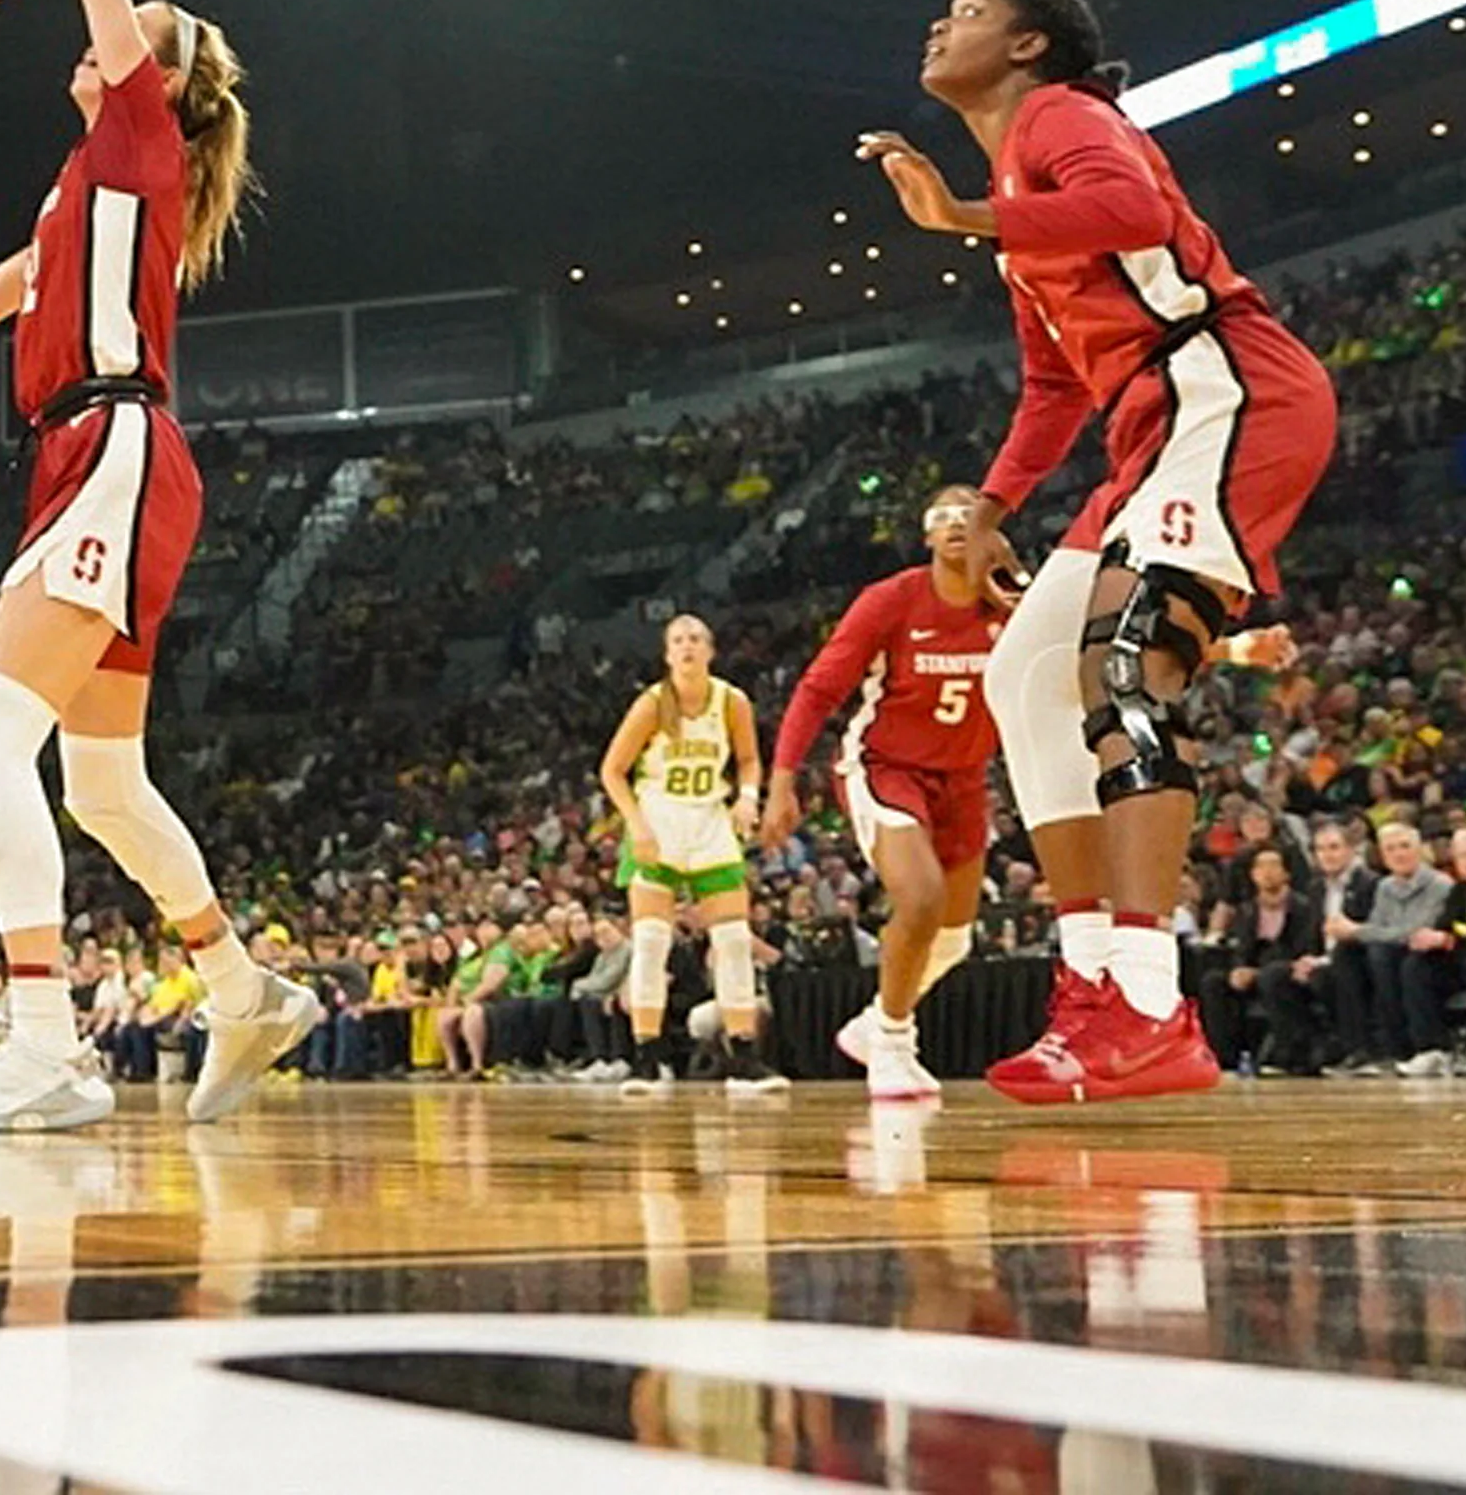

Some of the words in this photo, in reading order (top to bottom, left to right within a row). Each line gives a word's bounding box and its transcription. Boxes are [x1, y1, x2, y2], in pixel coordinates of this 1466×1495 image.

[1160, 499, 1196, 548] S
[73, 535, 107, 584] S
[934, 680, 973, 725] 5
[665, 765, 714, 798] 20
